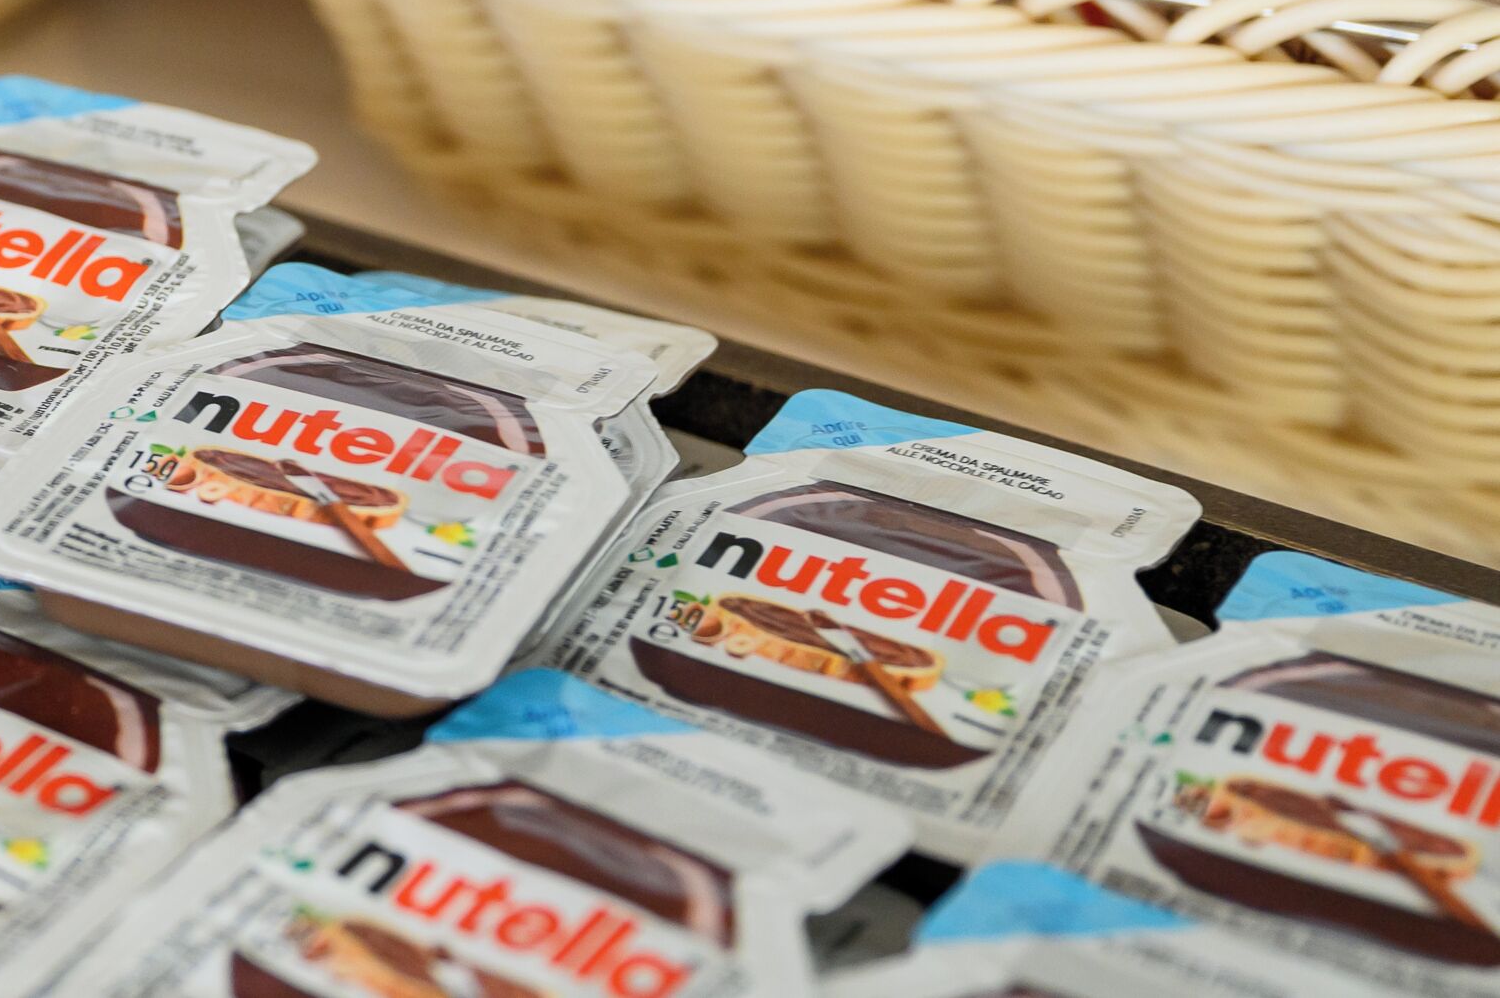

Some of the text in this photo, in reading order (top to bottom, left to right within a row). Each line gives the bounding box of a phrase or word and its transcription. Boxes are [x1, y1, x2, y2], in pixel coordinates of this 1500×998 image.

[389, 310, 524, 351] CREMA DA SPALMARE
[397, 320, 463, 344] NOCCIOLE
[472, 339, 490, 350] AL
[490, 344, 535, 363] CACAO
[174, 389, 516, 504] nutella
[811, 420, 869, 436] Aprire
[832, 434, 863, 448] qui
[128, 450, 179, 483] 15g
[886, 445, 1065, 501] ALLE NOCCIOLE E AL CACAO
[910, 442, 1052, 488] CREMA DA SPALMARE
[653, 595, 704, 633] 15g
[701, 532, 1057, 667] nutella
[336, 838, 692, 998] nutella
